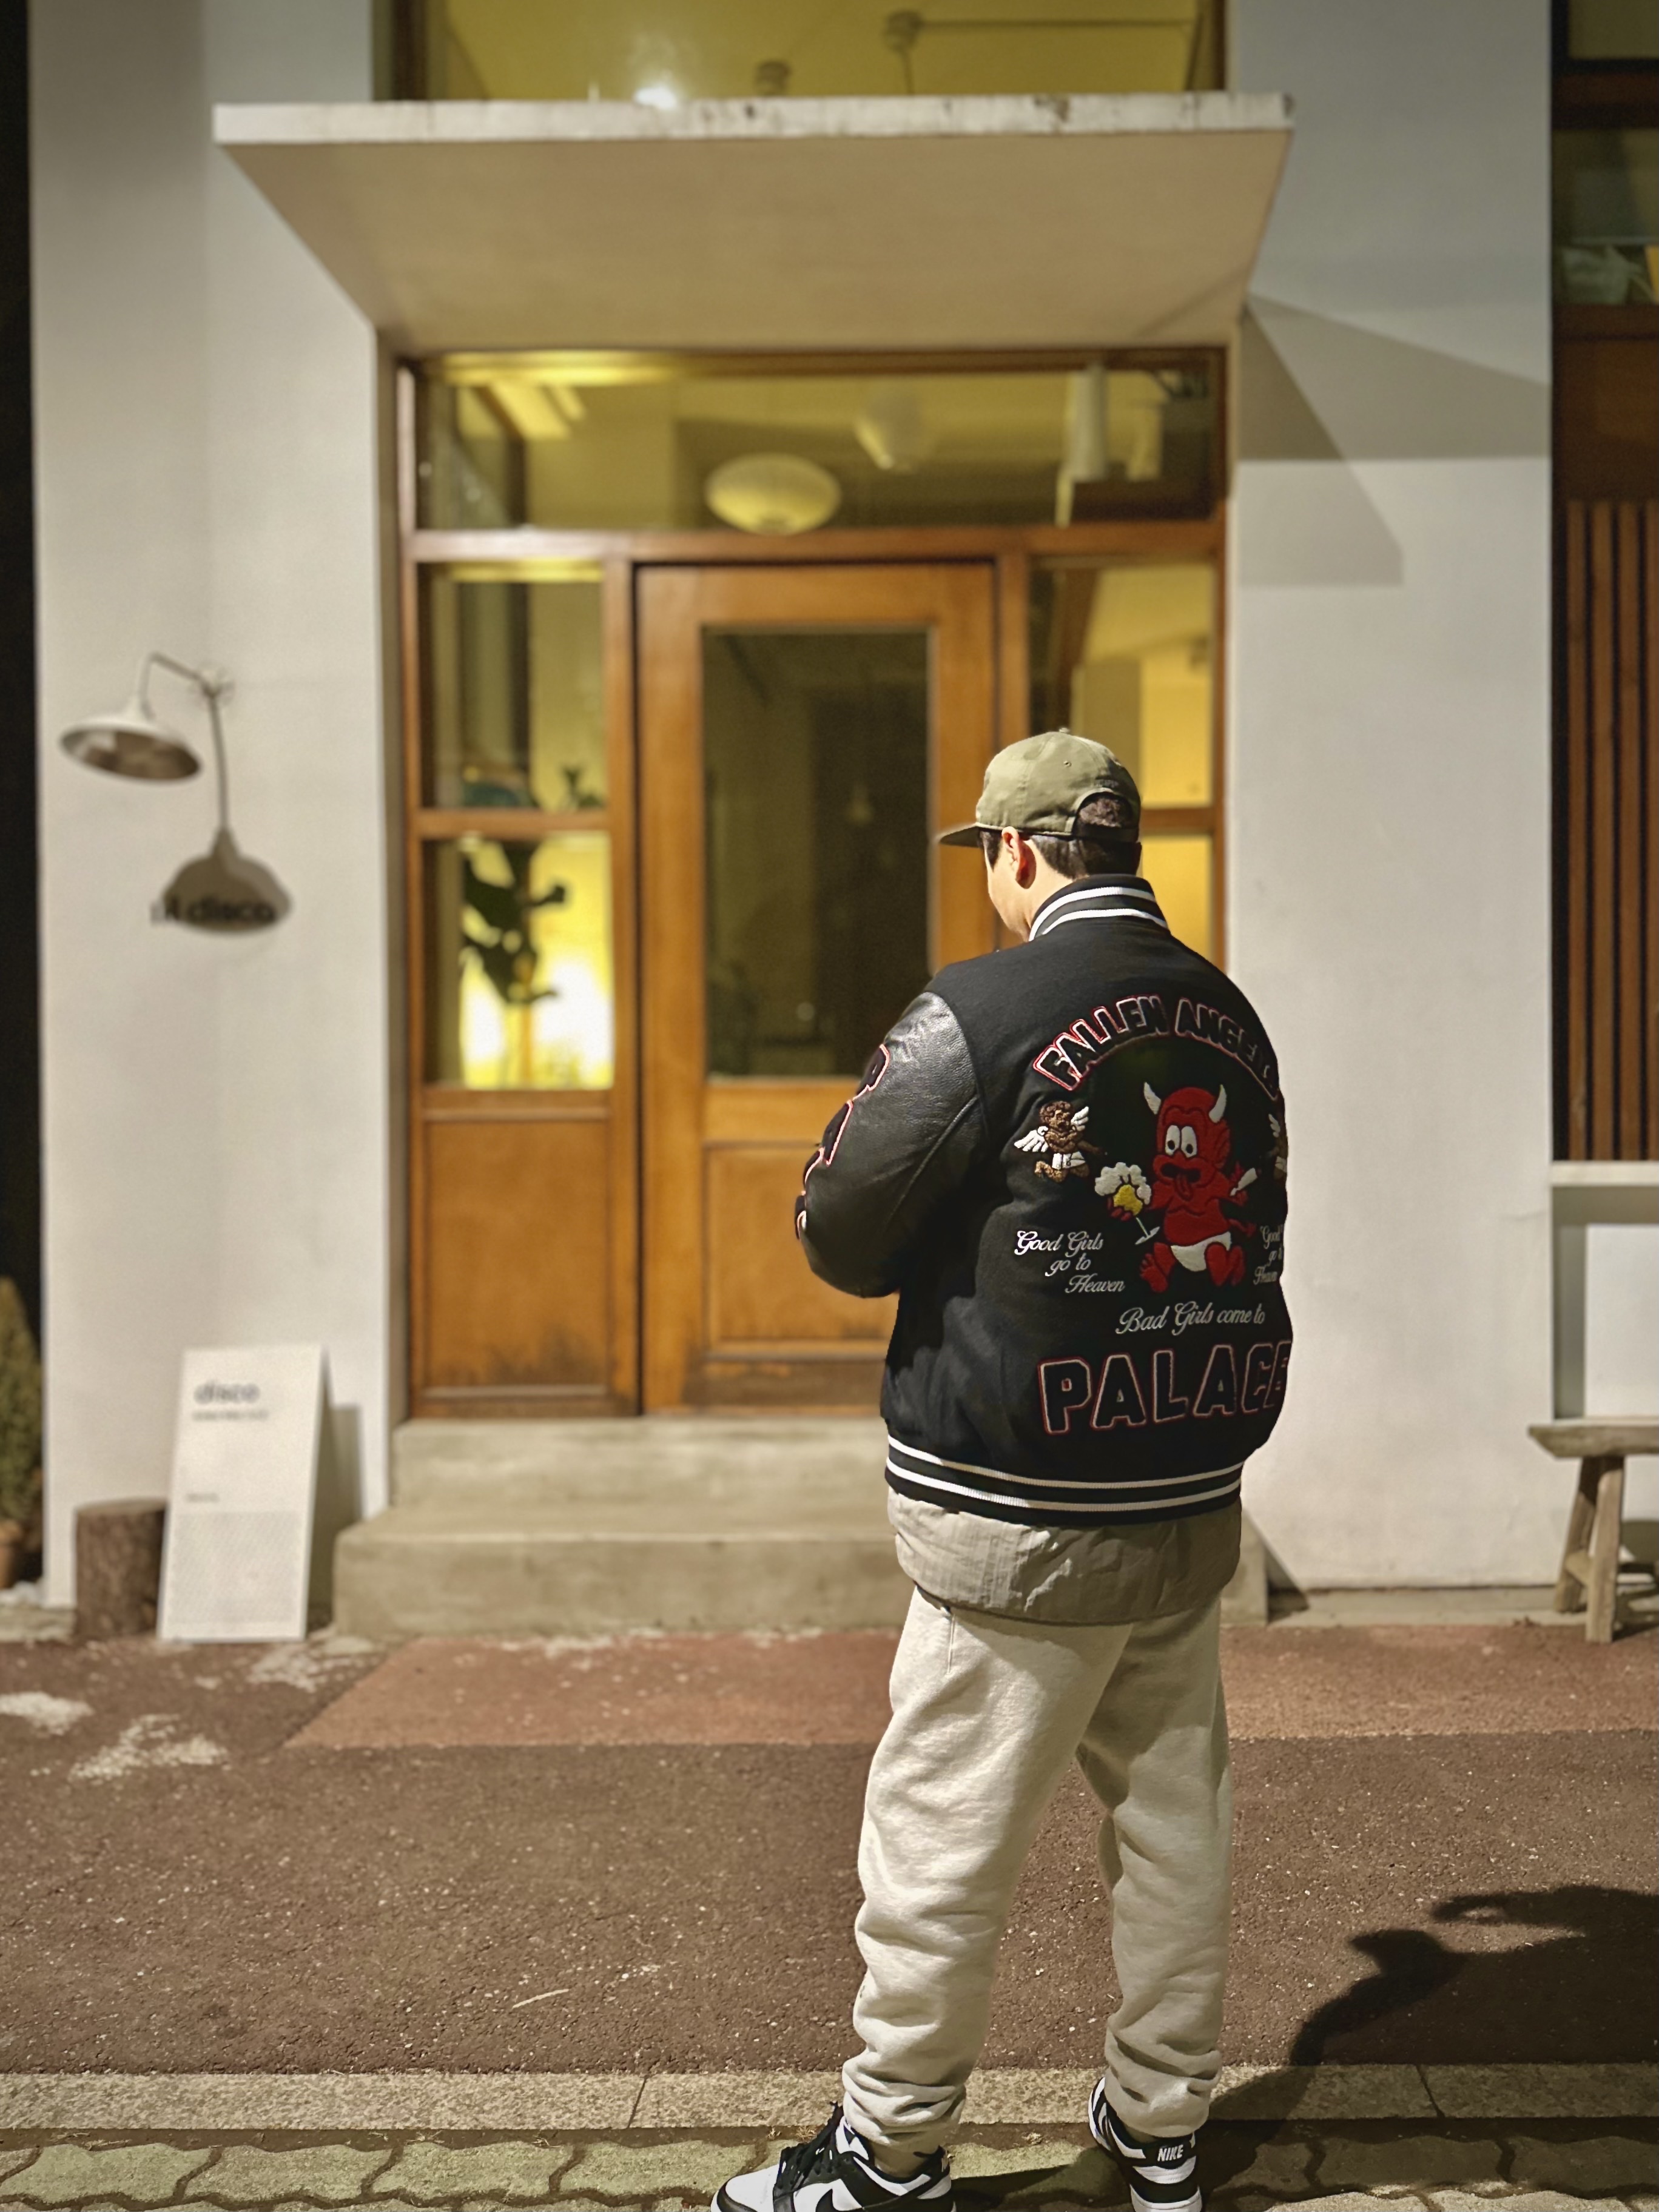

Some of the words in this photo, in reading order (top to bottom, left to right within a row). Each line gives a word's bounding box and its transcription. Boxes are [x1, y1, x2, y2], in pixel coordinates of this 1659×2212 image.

[1032, 992, 1170, 1091] FALLEN
[1014, 1231, 1064, 1256] Good
[1065, 1231, 1104, 1257] Girls
[1045, 1260, 1071, 1277] go
[1076, 1252, 1091, 1270] to
[1065, 1273, 1126, 1293] Heaven
[1116, 1306, 1170, 1334] Bad
[1171, 1301, 1214, 1336] Girls
[1217, 1309, 1252, 1323] come
[1253, 1303, 1265, 1324] to
[1038, 1340, 1292, 1435] PALACE
[1157, 2144, 1183, 2162] NIKE
